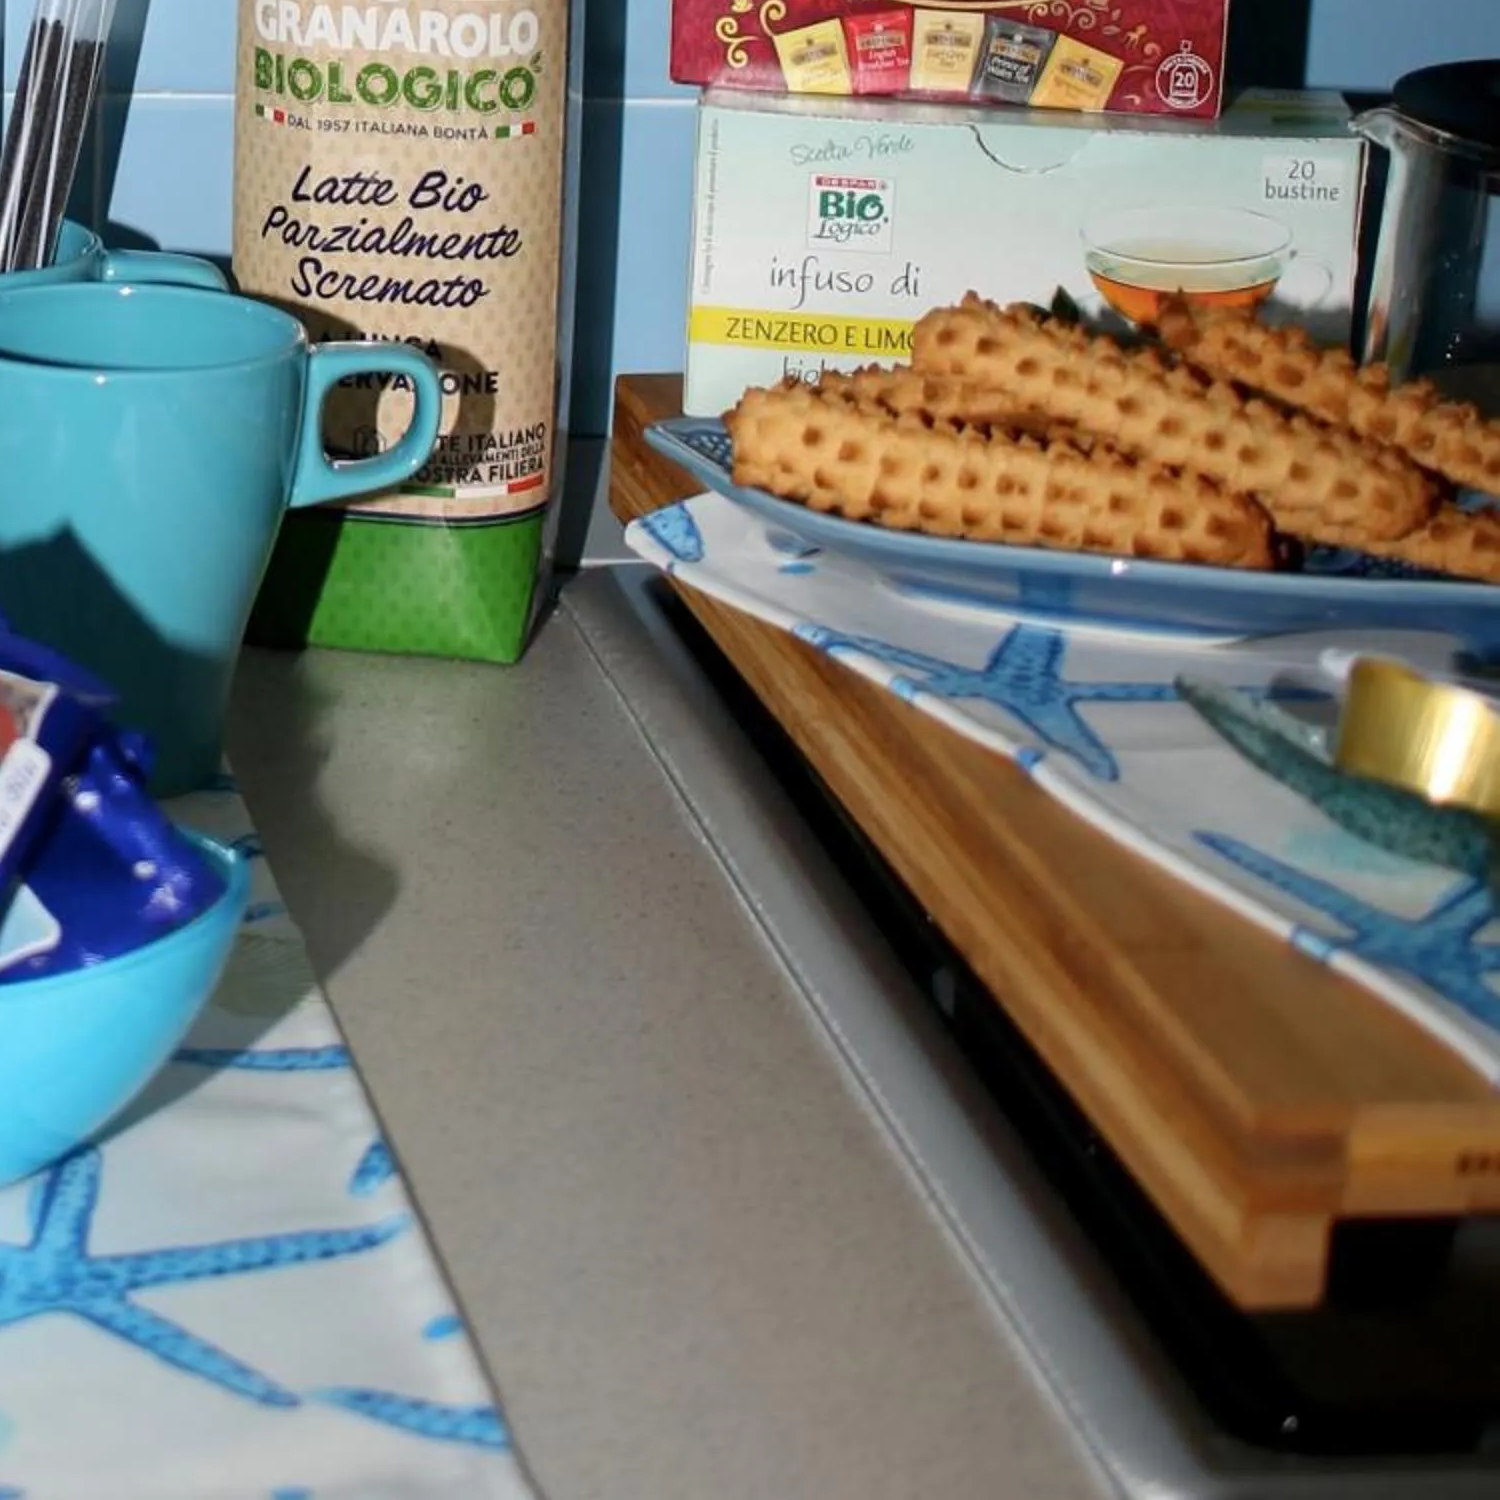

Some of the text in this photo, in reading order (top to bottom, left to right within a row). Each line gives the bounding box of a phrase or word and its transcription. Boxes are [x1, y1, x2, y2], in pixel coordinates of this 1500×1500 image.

[253, 46, 540, 114] BIOLOGICO
[1175, 71, 1195, 88] 20
[287, 114, 313, 131] DAL
[317, 118, 351, 133] 1957
[354, 119, 430, 139] ITALIANA
[1287, 159, 1316, 181] 20
[291, 164, 491, 214] Latte Bio
[1264, 176, 1341, 201] bustine
[260, 204, 524, 261] Parzialmente
[811, 219, 882, 243] Logico
[290, 256, 492, 308] Scremato
[770, 255, 922, 310] infuso di
[725, 316, 838, 346] ZENZERO
[844, 325, 858, 347] E
[468, 421, 547, 451] ITALIANO
[488, 457, 545, 483] FILIERA
